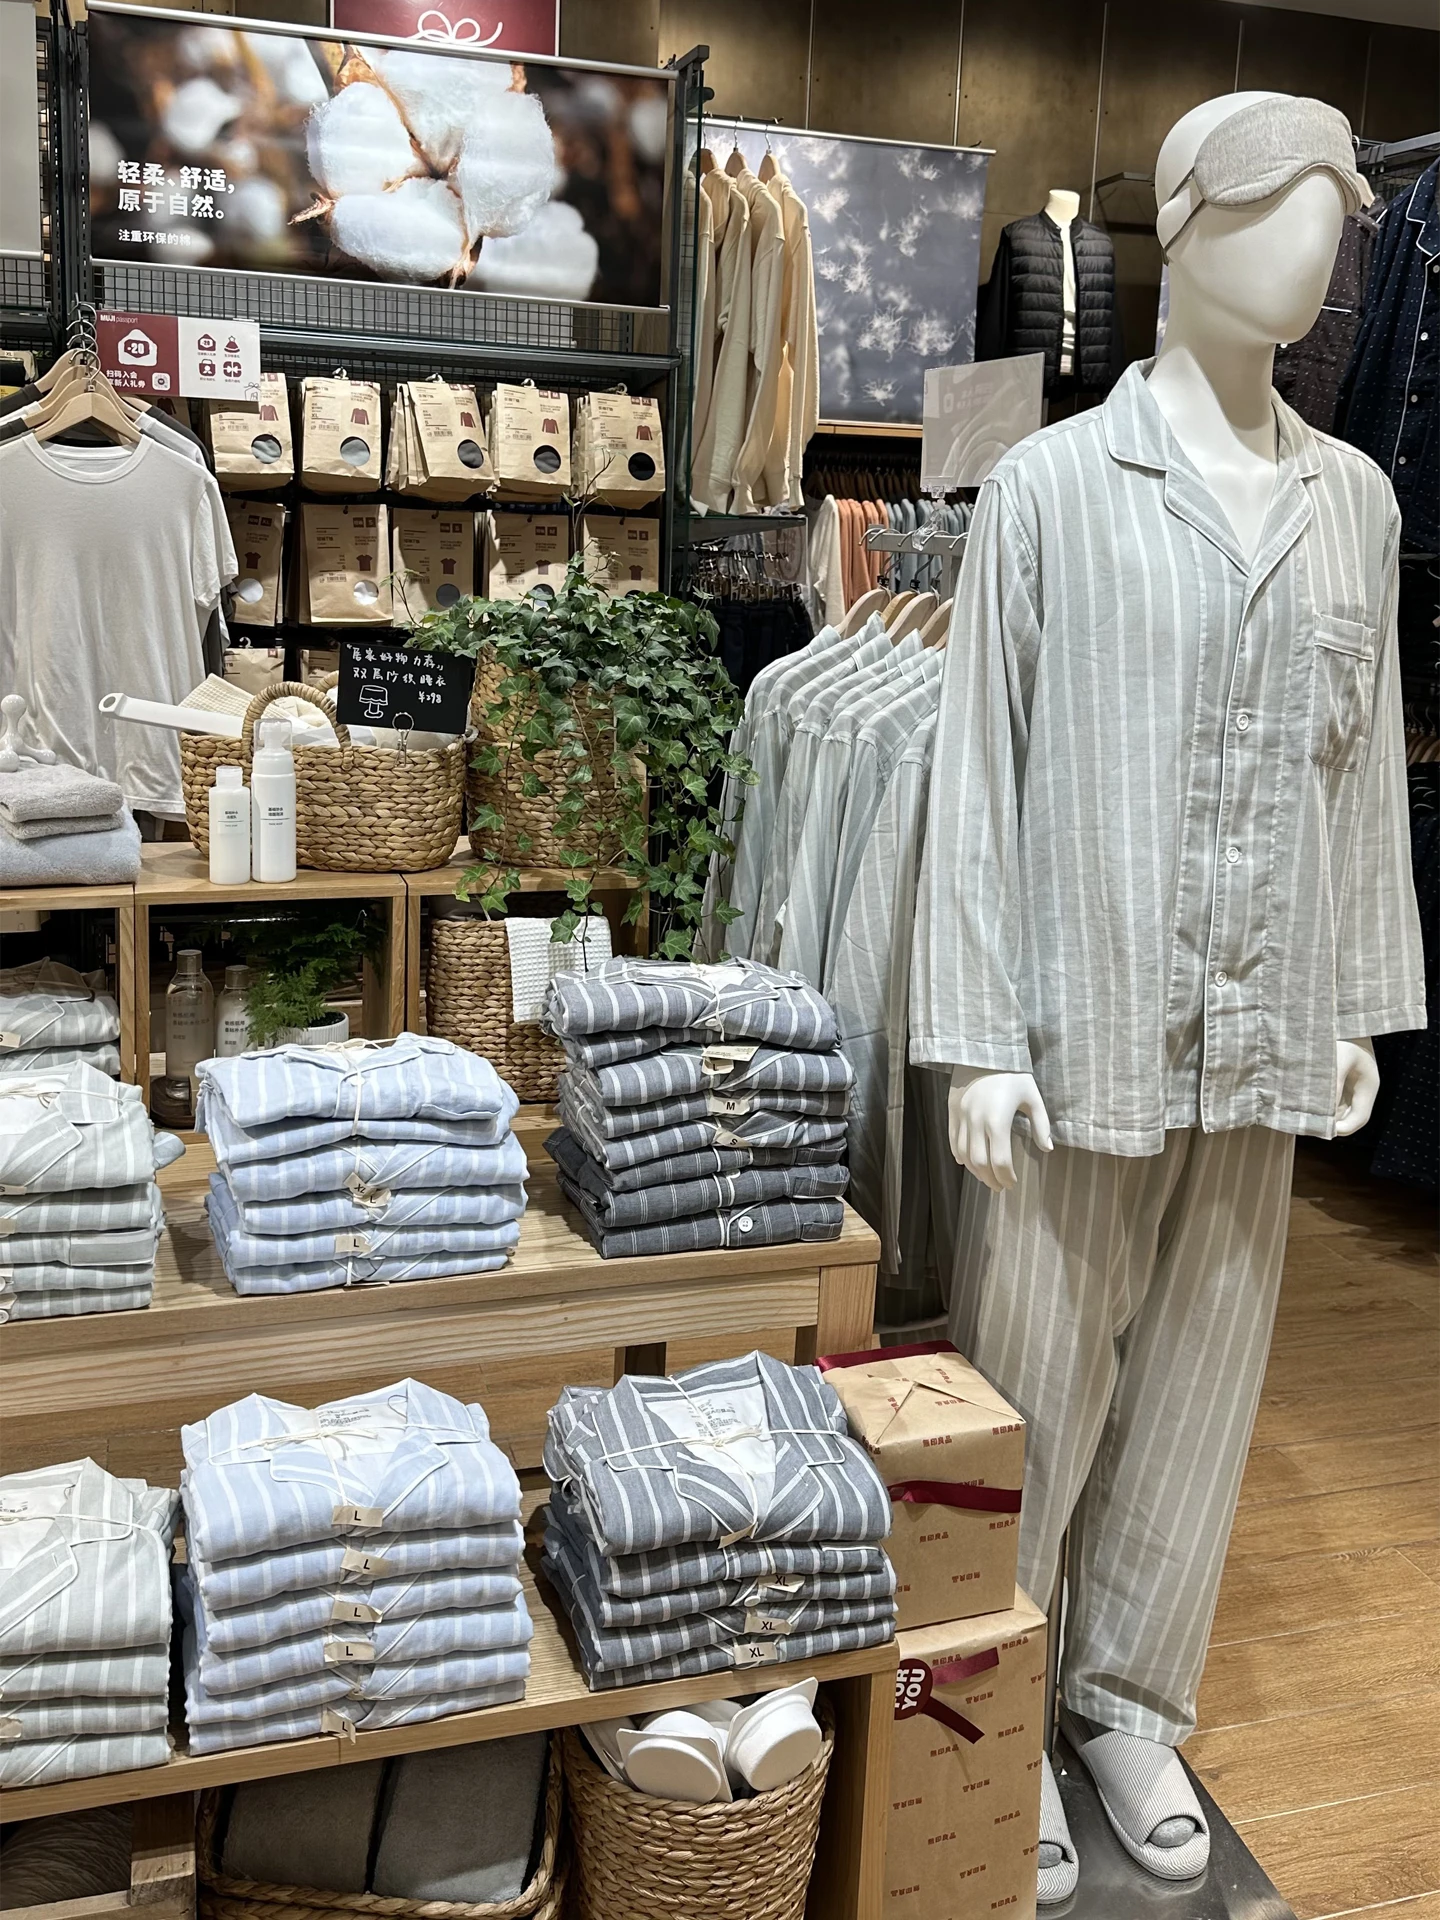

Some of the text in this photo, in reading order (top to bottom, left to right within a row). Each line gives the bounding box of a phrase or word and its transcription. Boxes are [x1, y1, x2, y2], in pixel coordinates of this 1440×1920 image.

[117, 188, 225, 219] 原于自然。
[100, 314, 138, 324] MUJI passport
[106, 369, 138, 379] 扫码入会
[726, 1102, 735, 1111] M
[730, 1138, 738, 1146] S
[370, 1195, 376, 1203] L
[353, 1238, 359, 1247] L
[992, 1423, 1021, 1436] 無印良品
[922, 1435, 953, 1448] 無印良品
[354, 1510, 362, 1521] L
[989, 1517, 1016, 1530] 無印良品
[920, 1531, 949, 1543] 無印良品
[363, 1559, 370, 1570] L
[775, 1575, 789, 1586] XL
[354, 1607, 361, 1618] L
[761, 1621, 776, 1630] XL
[1001, 1636, 1029, 1650] 無印良品
[346, 1645, 353, 1656] L
[749, 1648, 764, 1658] XL
[932, 1653, 962, 1666] 無印良品
[901, 1669, 926, 1710] YOU
[342, 1721, 348, 1732] L
